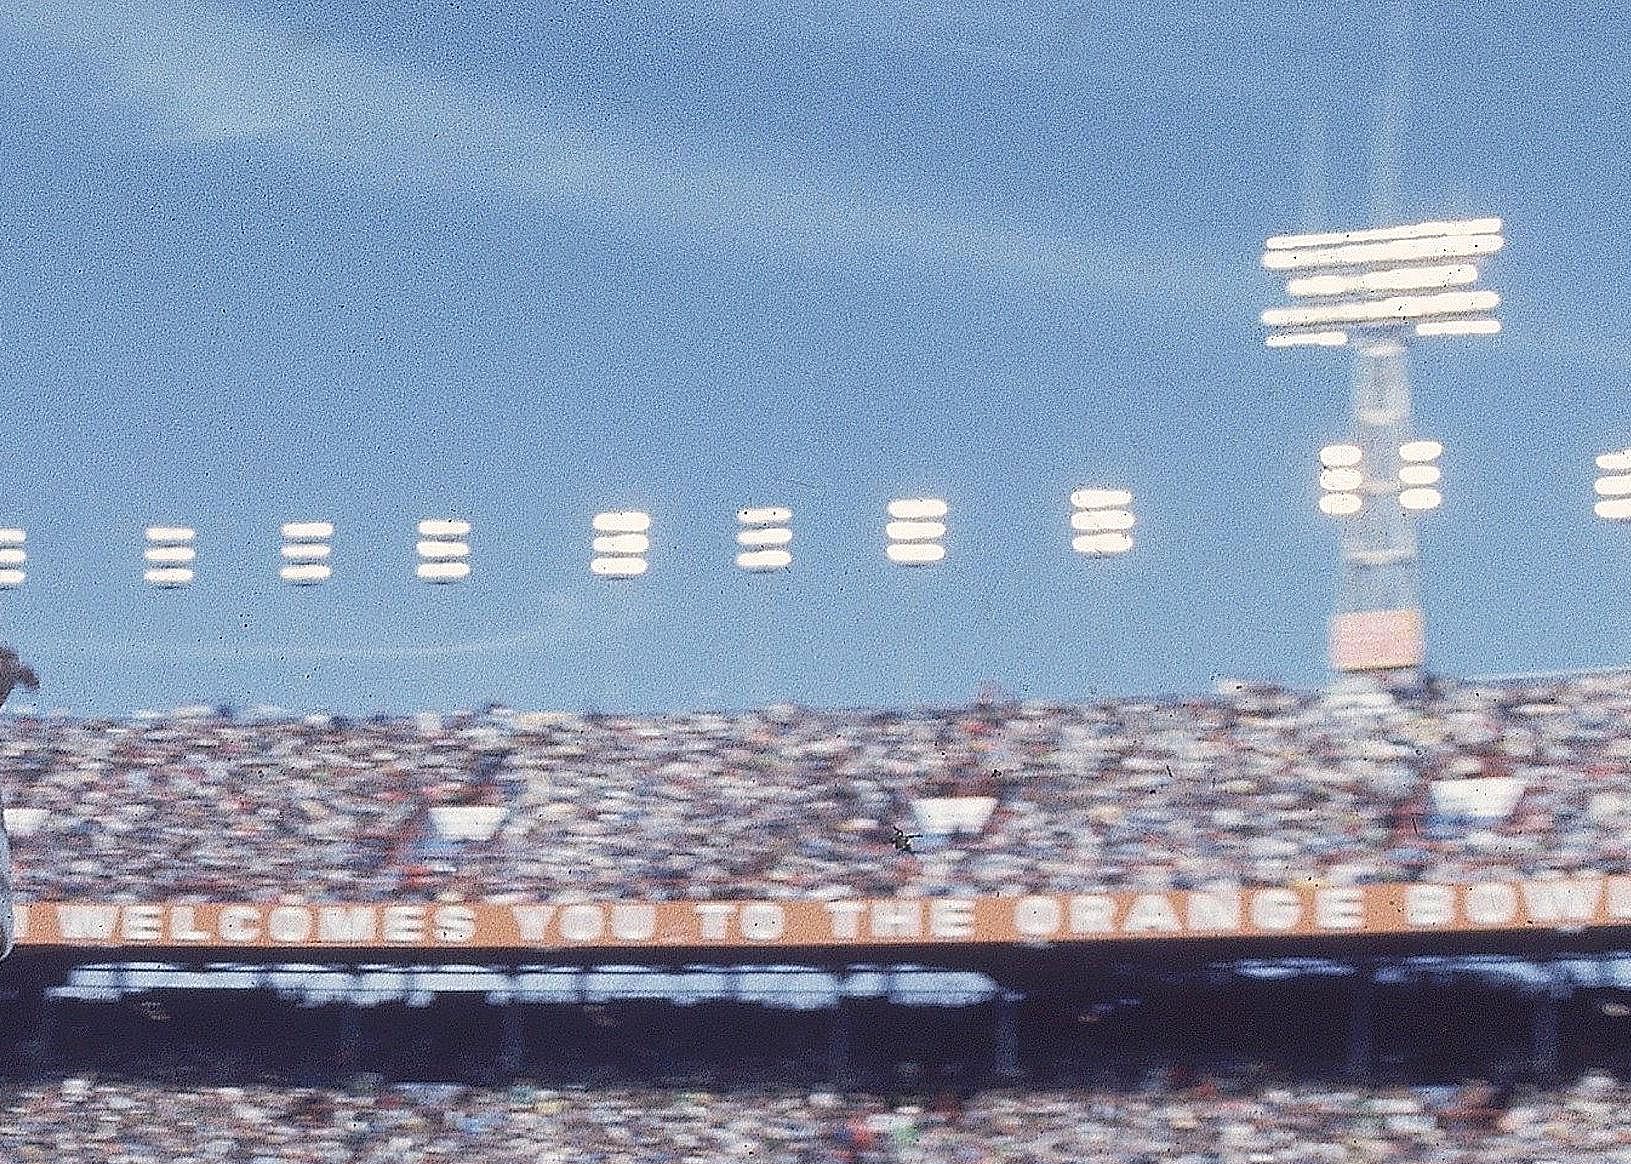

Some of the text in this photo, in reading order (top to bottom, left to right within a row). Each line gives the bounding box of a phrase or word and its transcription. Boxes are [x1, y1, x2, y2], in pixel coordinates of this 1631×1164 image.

[58, 903, 475, 943] WELCOMES
[512, 903, 658, 941] YOU
[694, 903, 785, 940] TO
[824, 900, 976, 940] THE
[1015, 888, 1365, 934] ORANGE
